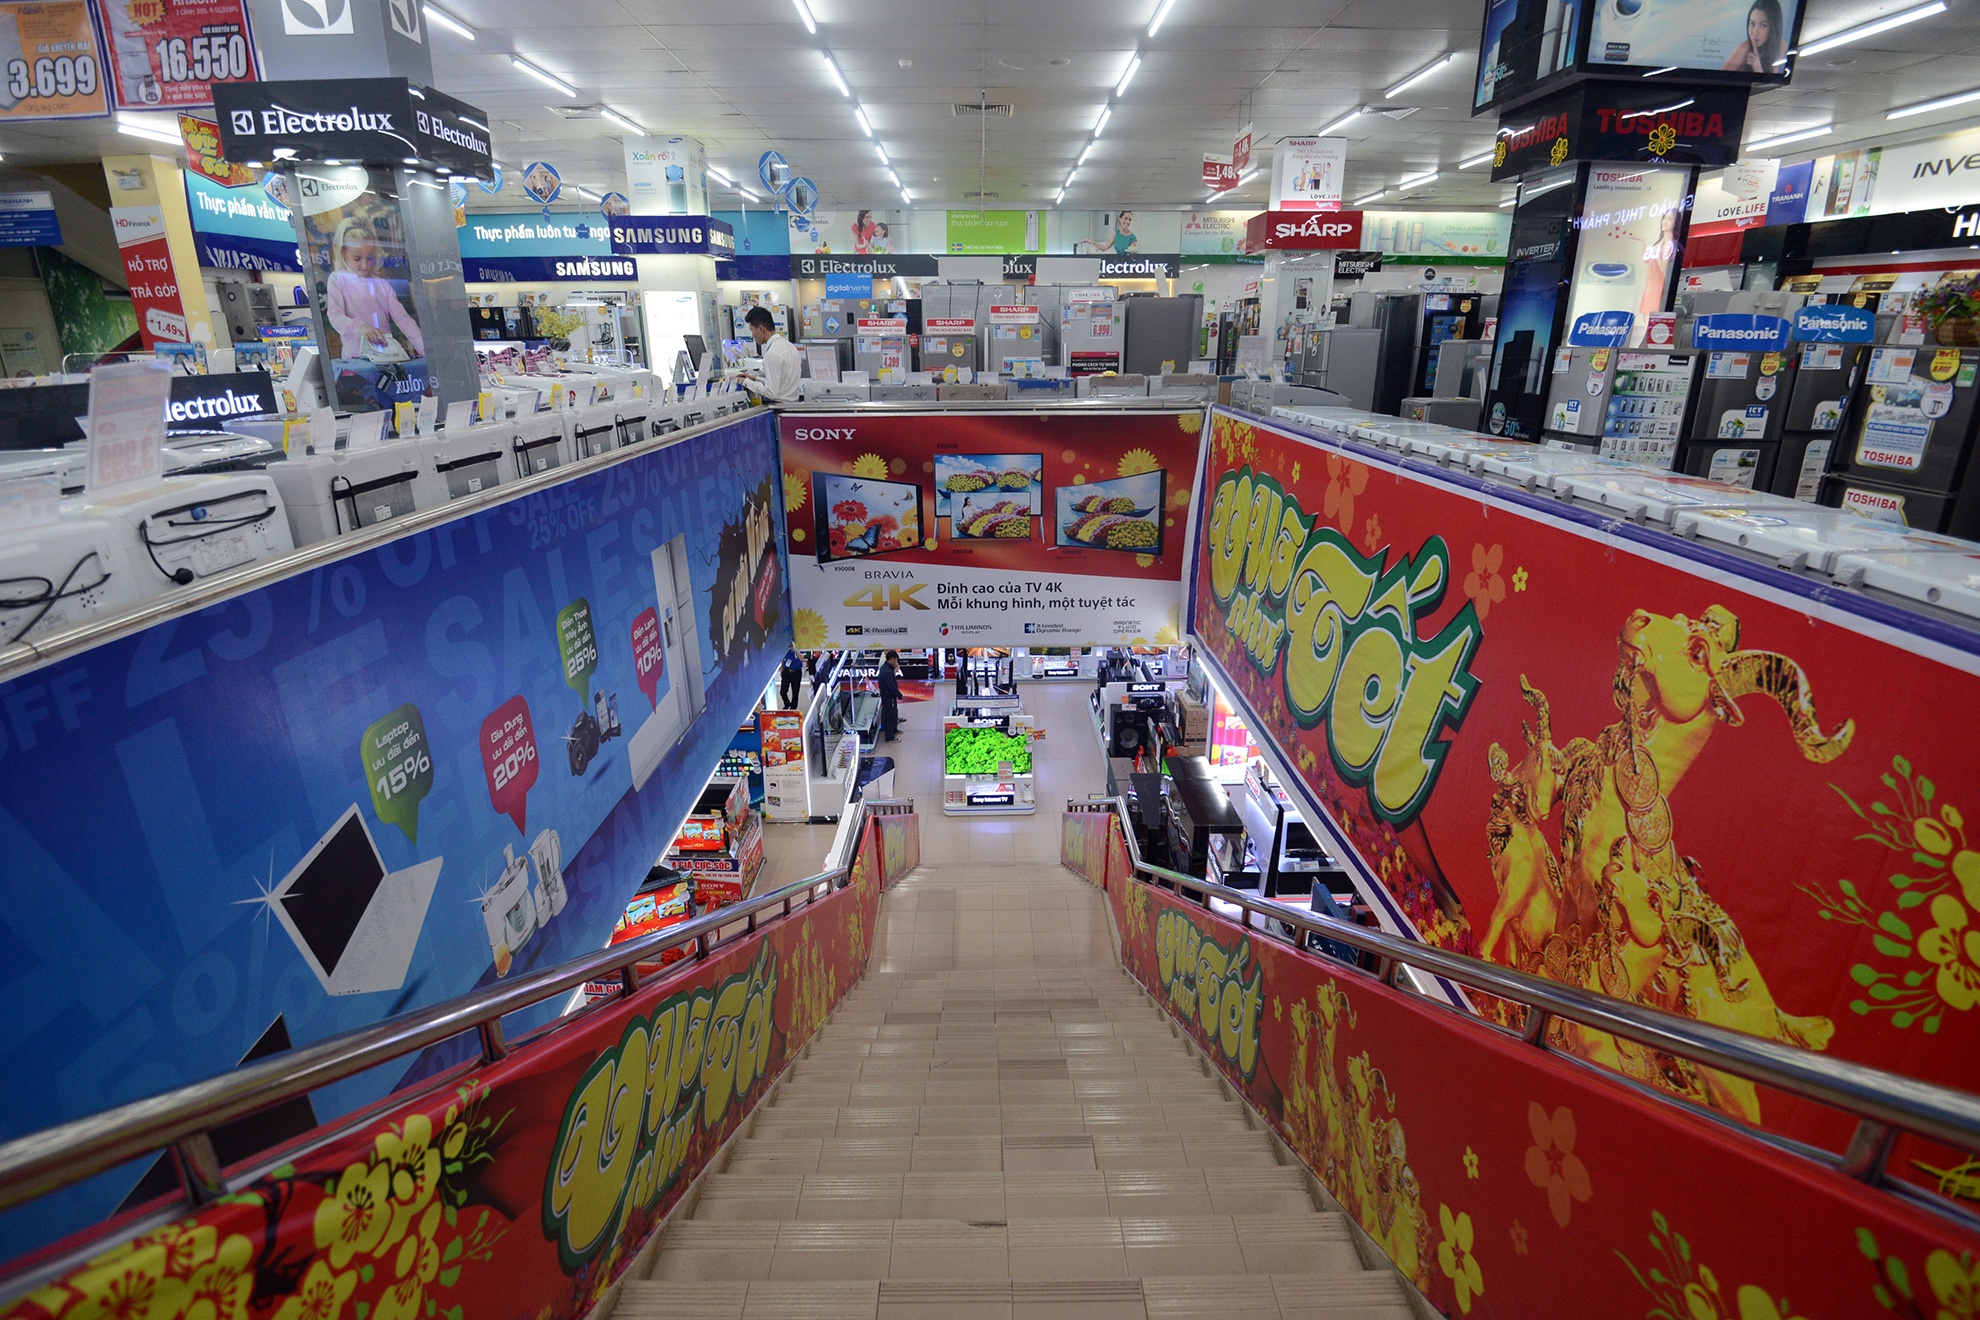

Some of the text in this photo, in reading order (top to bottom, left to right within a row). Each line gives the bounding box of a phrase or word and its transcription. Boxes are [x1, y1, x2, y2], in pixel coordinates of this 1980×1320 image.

[134, 2, 159, 18] HOT
[155, 35, 247, 82] 16.550
[9, 55, 97, 98] 3.699
[262, 106, 395, 135] Electrolux
[1596, 107, 1724, 138] TOSHIBA
[433, 117, 488, 155] Electrolux
[1503, 112, 1569, 152] TOSHIBA
[321, 182, 358, 191] Electrolux
[1595, 172, 1643, 183] TOSHIBA
[196, 191, 276, 221] Thực phẩm vẫn
[1772, 192, 1804, 203] TRANANH
[1717, 203, 1766, 218] LOVE.LIFE
[473, 223, 562, 243] Thực phẩm luôn
[613, 227, 703, 244] SAMSUNG
[709, 228, 736, 250] SAMSUNG
[1275, 223, 1353, 237] SHARP
[1517, 243, 1554, 257] INVERTER
[128, 254, 168, 273] HỖ TRỢ
[555, 261, 634, 277] SAMSUNG
[819, 259, 898, 275] Electrolux
[1100, 259, 1169, 274] lectrolux
[1338, 261, 1374, 269] MITSUBISHI
[130, 282, 178, 299] TRẢ GÓP
[156, 320, 185, 338] 1.49%
[1578, 322, 1628, 336] Panasonic
[1798, 315, 1868, 331] Panasonic
[1698, 325, 1779, 340] Panasonic
[165, 389, 264, 423] lectrolux
[1568, 400, 1578, 408] ICY
[795, 428, 856, 440] SONY
[1504, 419, 1521, 437] 50%
[1863, 450, 1914, 467] TOSHIBA
[1847, 491, 1897, 511] TOSHIBA
[864, 570, 915, 579] BRAVIA
[972, 584, 995, 594] cao
[998, 581, 1022, 594] của
[1025, 582, 1042, 593] TV
[1045, 582, 1062, 593] 4K
[843, 583, 931, 611] 4K
[937, 595, 1136, 611] Mỗi khung hình, một tuyệt tác
[561, 606, 588, 631] Điện Thoại
[565, 621, 589, 642] Máy Ảnh
[633, 616, 656, 641] Điện Lạnh
[846, 627, 899, 635] 4K X-Reality
[951, 624, 993, 632] TRILUMINOS
[566, 643, 598, 679] 25%
[637, 642, 663, 677] 10%
[1285, 548, 1473, 812] Tết
[375, 720, 410, 750] Laptop
[490, 713, 524, 744] Gia Dụng
[372, 729, 421, 772] ưu đãi đến
[492, 723, 528, 761] ưu đãi đến
[376, 749, 431, 801] 15%
[493, 740, 536, 792] 20%
[678, 860, 693, 869] GIÁ
[1197, 940, 1262, 1076] Tết
[699, 936, 778, 1132] Tết
